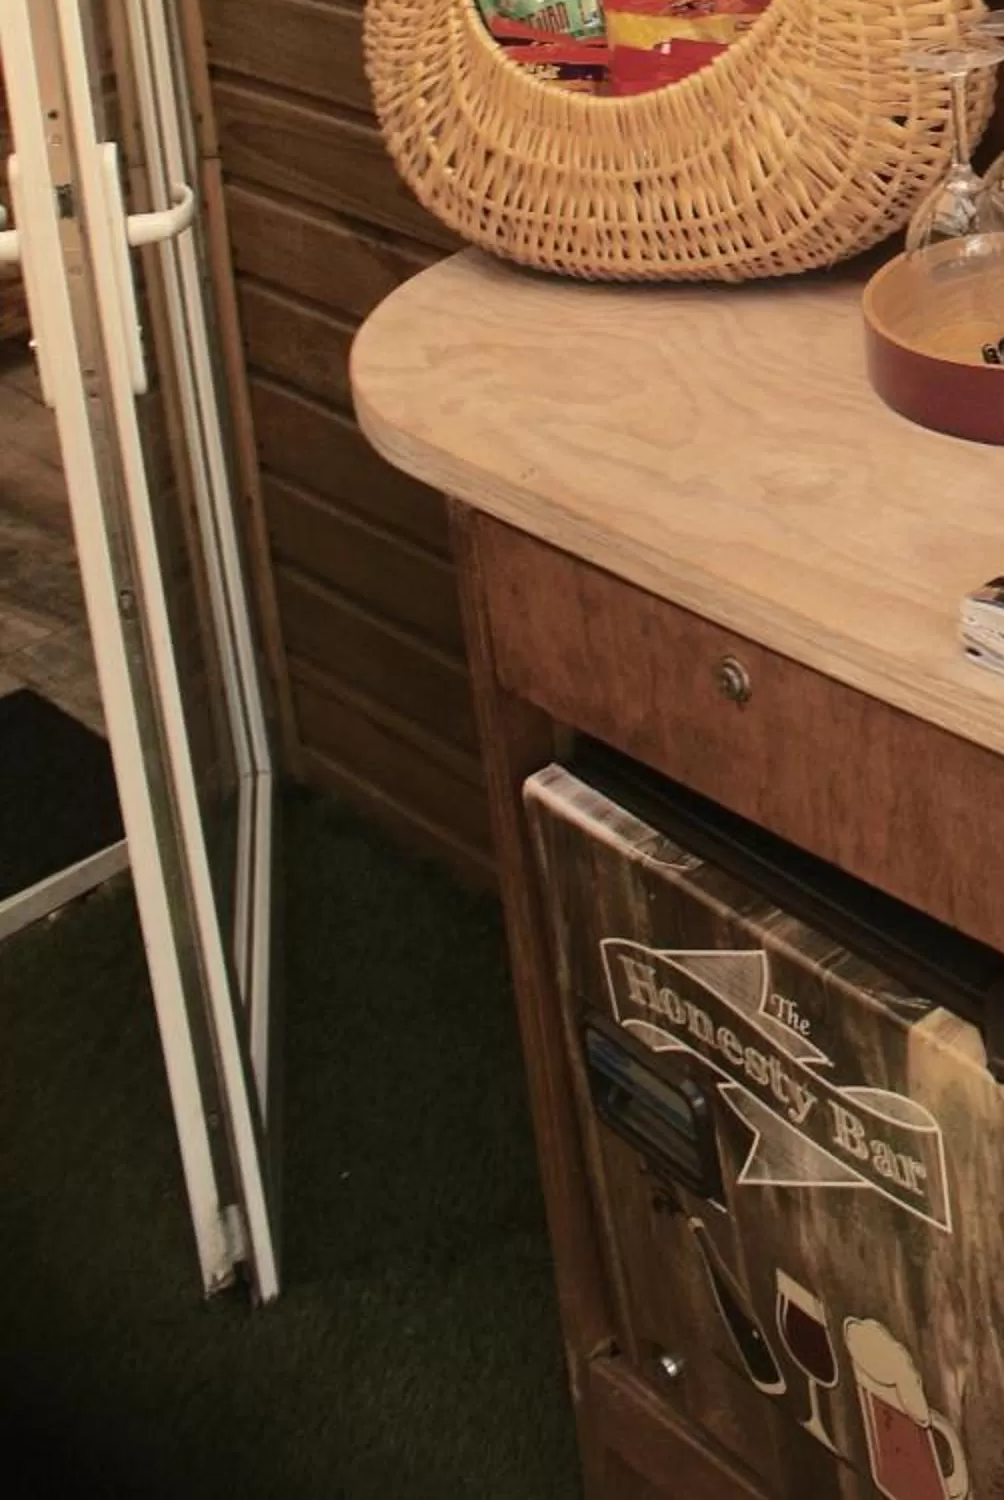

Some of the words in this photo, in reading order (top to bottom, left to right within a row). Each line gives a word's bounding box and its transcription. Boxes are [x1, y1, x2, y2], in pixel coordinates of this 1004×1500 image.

[616, 953, 817, 1123] Honesty
[826, 1098, 927, 1197] Bar
[769, 994, 812, 1037] The
